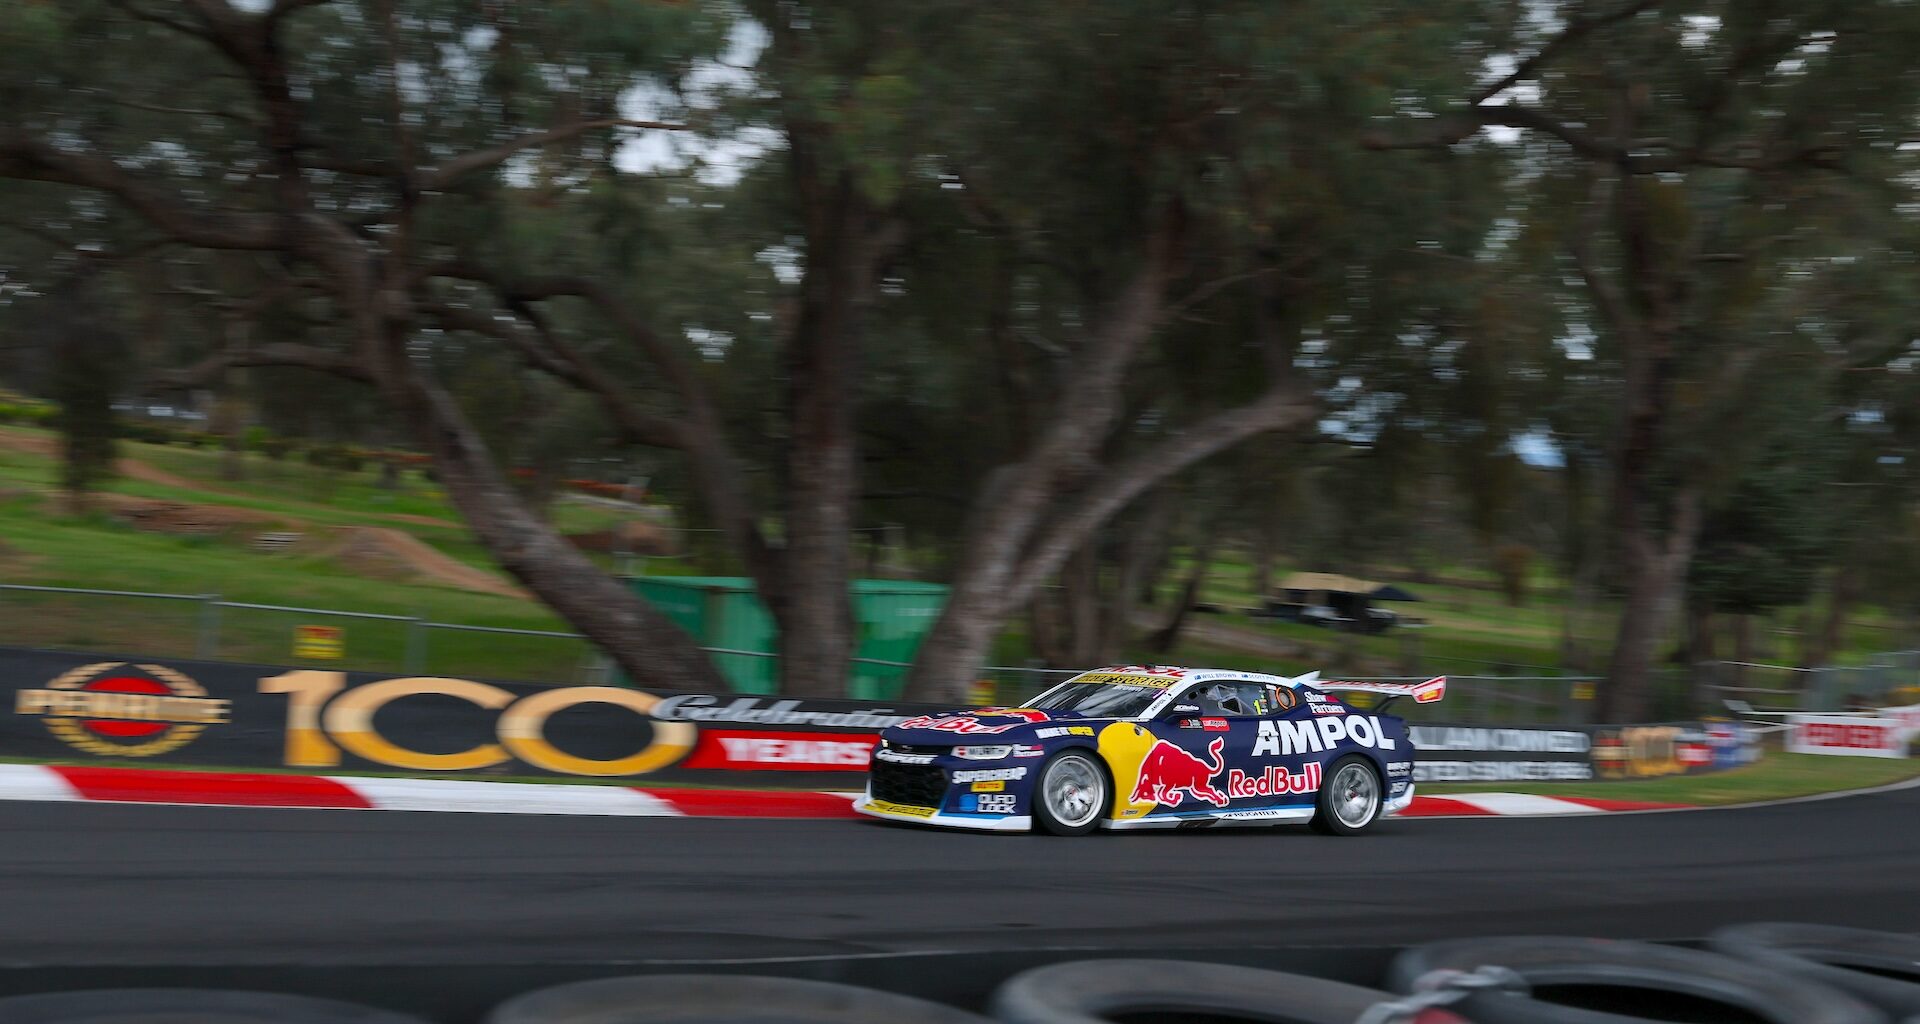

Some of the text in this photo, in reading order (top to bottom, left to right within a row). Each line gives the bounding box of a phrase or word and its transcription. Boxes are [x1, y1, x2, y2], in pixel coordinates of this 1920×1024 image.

[1251, 715, 1395, 756] AMPOL
[717, 737, 876, 766] YEARS
[951, 767, 1028, 783] SUPERCHEAP
[977, 803, 1017, 814] LOCK
